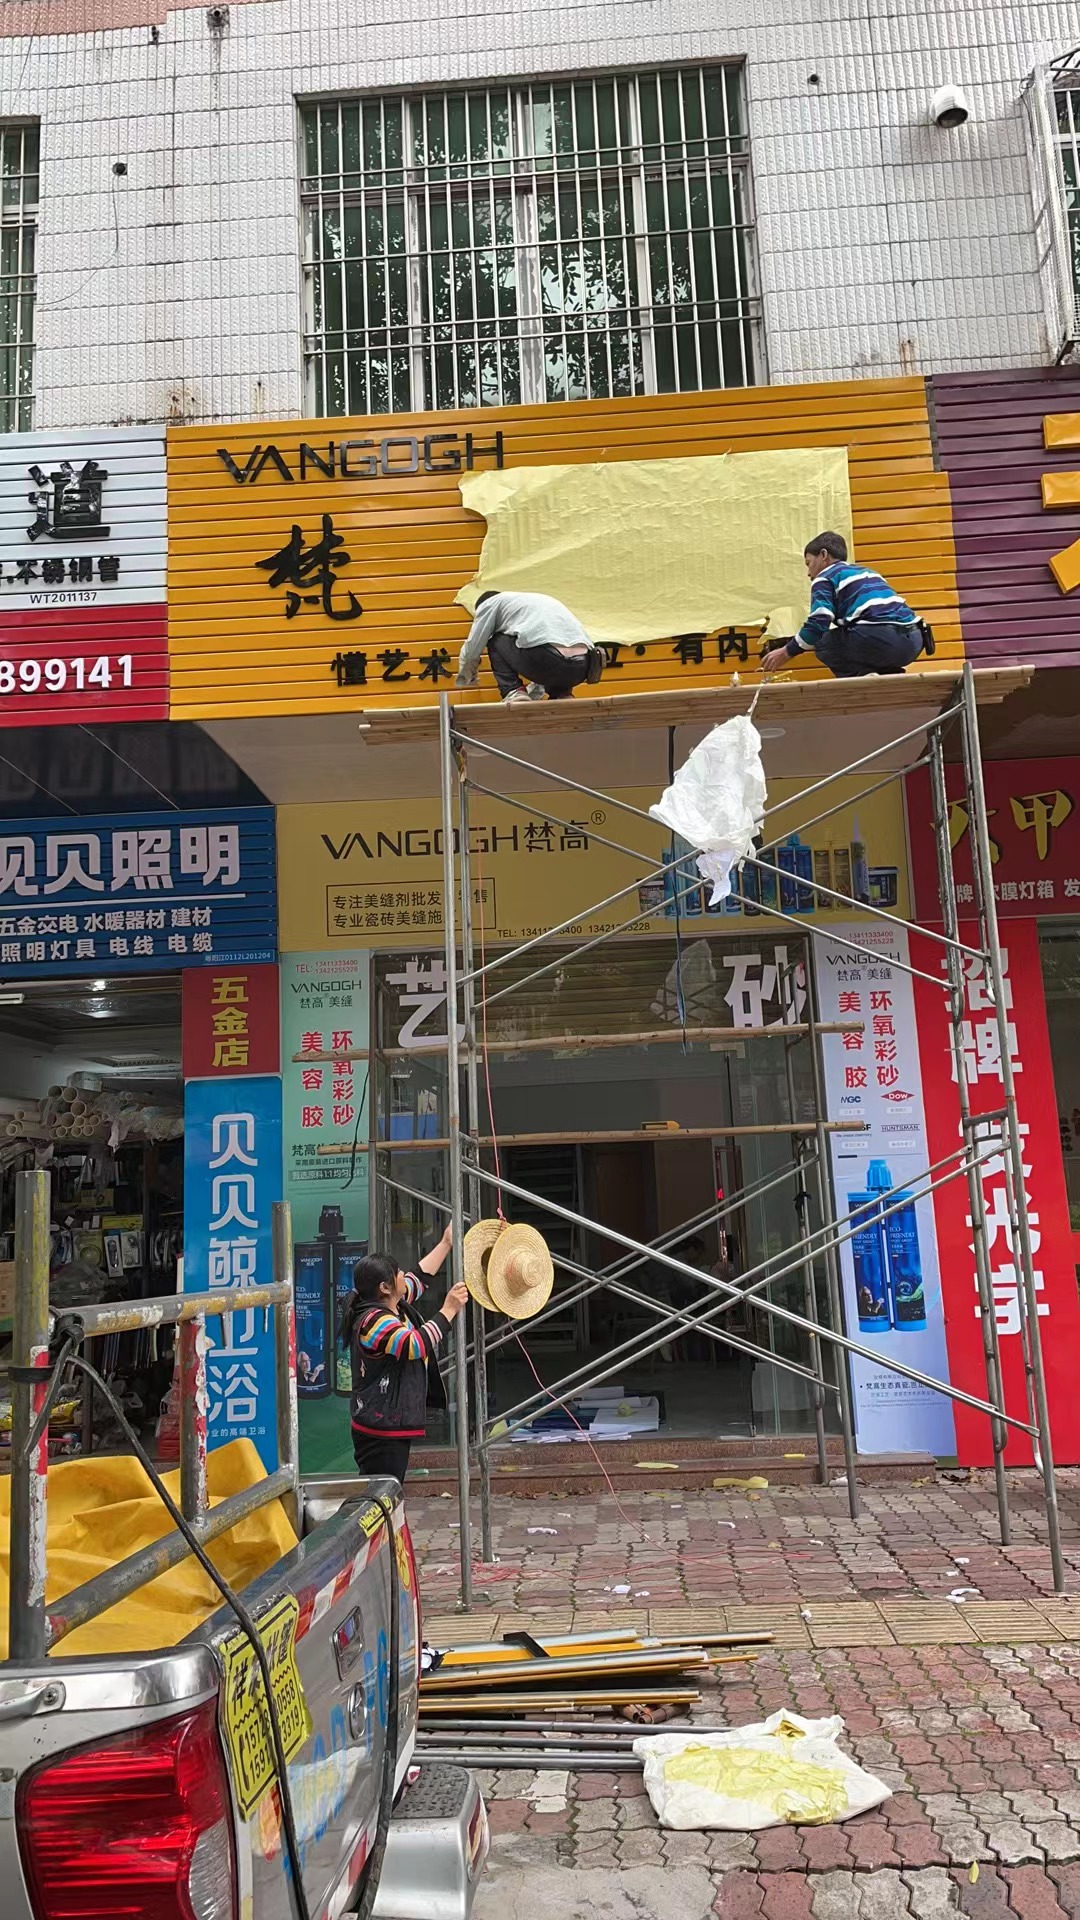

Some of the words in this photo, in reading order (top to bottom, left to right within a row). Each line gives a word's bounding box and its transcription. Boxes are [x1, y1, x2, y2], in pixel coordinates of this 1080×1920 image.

[216, 429, 504, 483] VANGOGH
[27, 459, 111, 541] 道
[0, 556, 120, 586] .不锈钢管
[30, 591, 98, 604] WT2011137
[320, 823, 519, 860] VANGOGH
[332, 890, 442, 910] 专注美缝剂批发
[0, 914, 79, 937] 五金交电
[84, 909, 166, 933] 水暖器材
[171, 906, 213, 928] 建材
[497, 929, 517, 938] TEL:
[521, 925, 582, 937] 134113400
[588, 922, 651, 934] 134215228
[1, 938, 96, 963] 照明灯具
[109, 935, 154, 957] 电线
[168, 932, 214, 954] 电缆
[291, 979, 362, 993] VANGOGH
[211, 976, 249, 1068] 五金店
[840, 1095, 862, 1104] MGC
